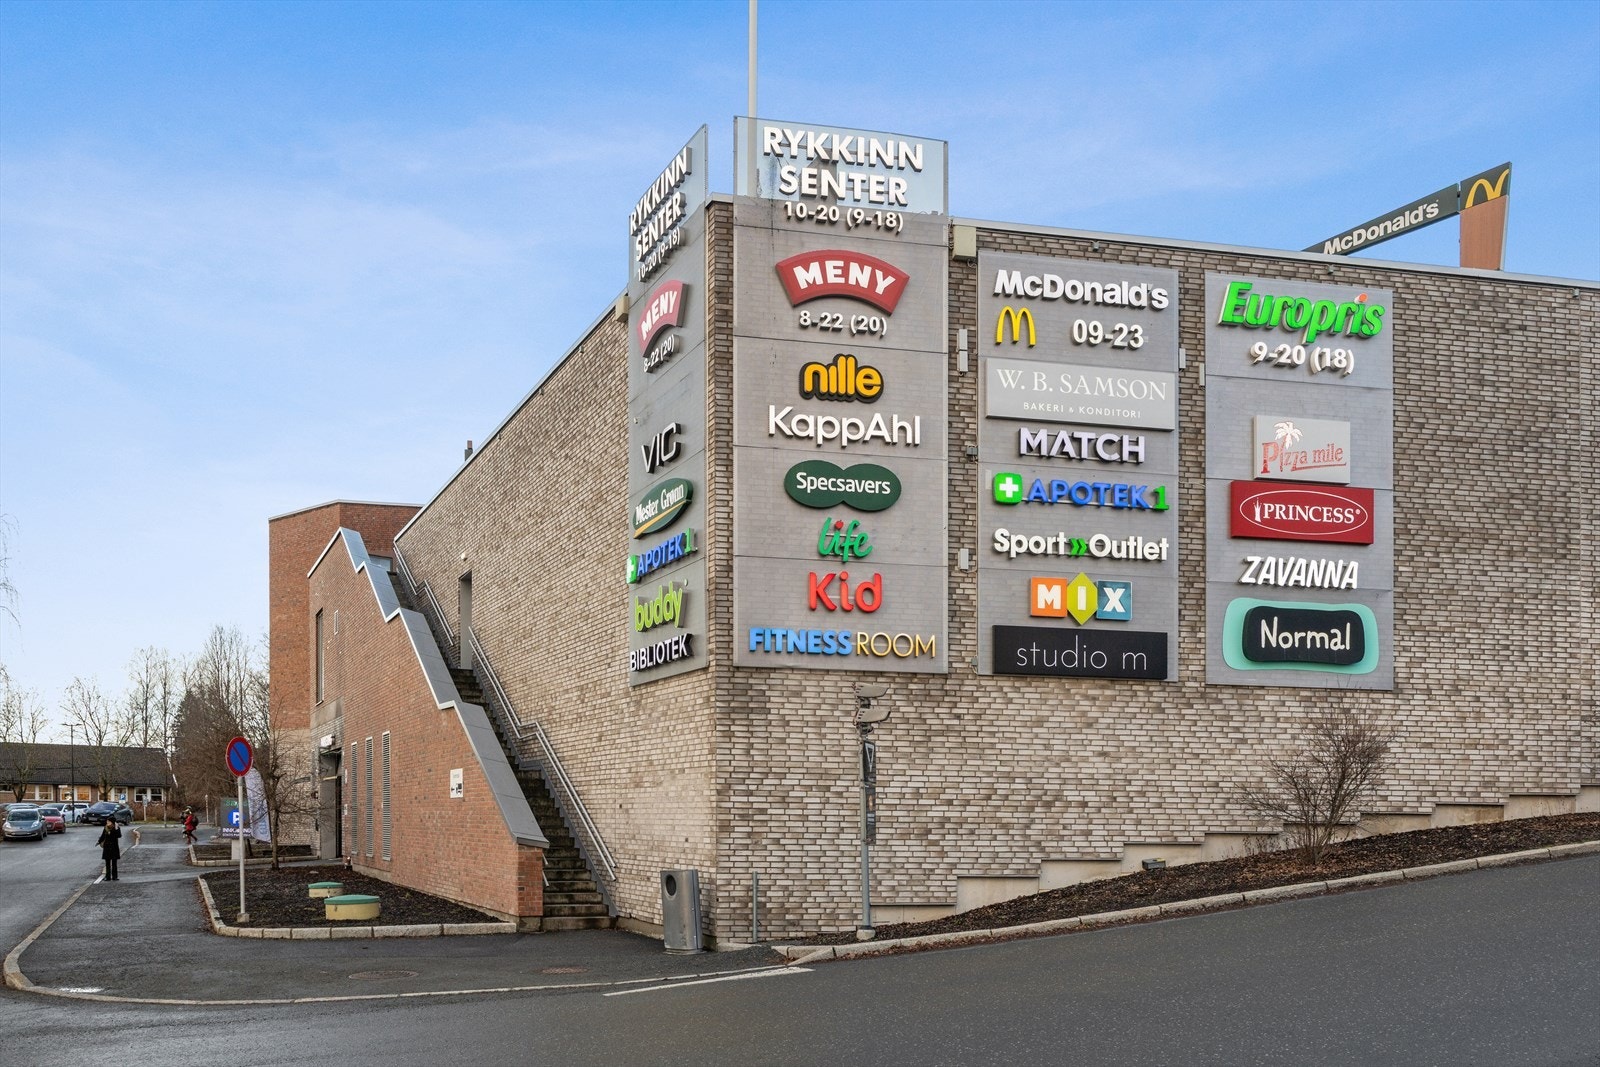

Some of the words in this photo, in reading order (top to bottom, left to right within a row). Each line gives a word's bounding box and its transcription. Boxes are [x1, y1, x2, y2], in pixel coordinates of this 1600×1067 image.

[763, 126, 923, 172] RYKKINN
[630, 146, 688, 236] RYKKINN
[779, 165, 908, 207] SENTER
[635, 191, 683, 262] SENTER
[784, 201, 840, 225] 10-20
[846, 207, 904, 234] (9-18)
[1323, 200, 1439, 255] McDonald's
[638, 251, 657, 281] 10-20
[793, 260, 896, 295] MENY
[993, 269, 1170, 310] McDonald's
[641, 290, 677, 341] MENY
[799, 310, 844, 331] 8-22
[850, 314, 888, 338] (20)
[1218, 281, 1386, 345] Europris
[1072, 318, 1145, 350] 09-23
[803, 354, 882, 398] nille
[1250, 341, 1306, 367] 9-20
[1310, 346, 1355, 376] (18)
[996, 368, 1026, 391] W.
[1032, 371, 1053, 393] B.
[1060, 373, 1167, 401] SAMSON
[768, 404, 922, 449] KappAhl
[1023, 401, 1065, 414] BAKERI
[1079, 406, 1142, 419] KONDITORI
[1019, 427, 1145, 463] MATCH
[1261, 437, 1308, 474] Pizza
[1312, 443, 1344, 464] mile
[796, 471, 891, 495] Specsavers
[1263, 502, 1355, 524] PRINCESS
[1240, 556, 1359, 590] ZAVANNA
[635, 580, 683, 632] buddy
[808, 571, 882, 613] Kid
[1036, 583, 1126, 613] MIX
[749, 627, 852, 656] FITNESS
[856, 631, 936, 658] ROOM
[1260, 616, 1351, 651] Normal
[630, 633, 690, 672] BIBLIOTEK
[1016, 634, 1108, 669] studio
[1122, 651, 1147, 671] m
